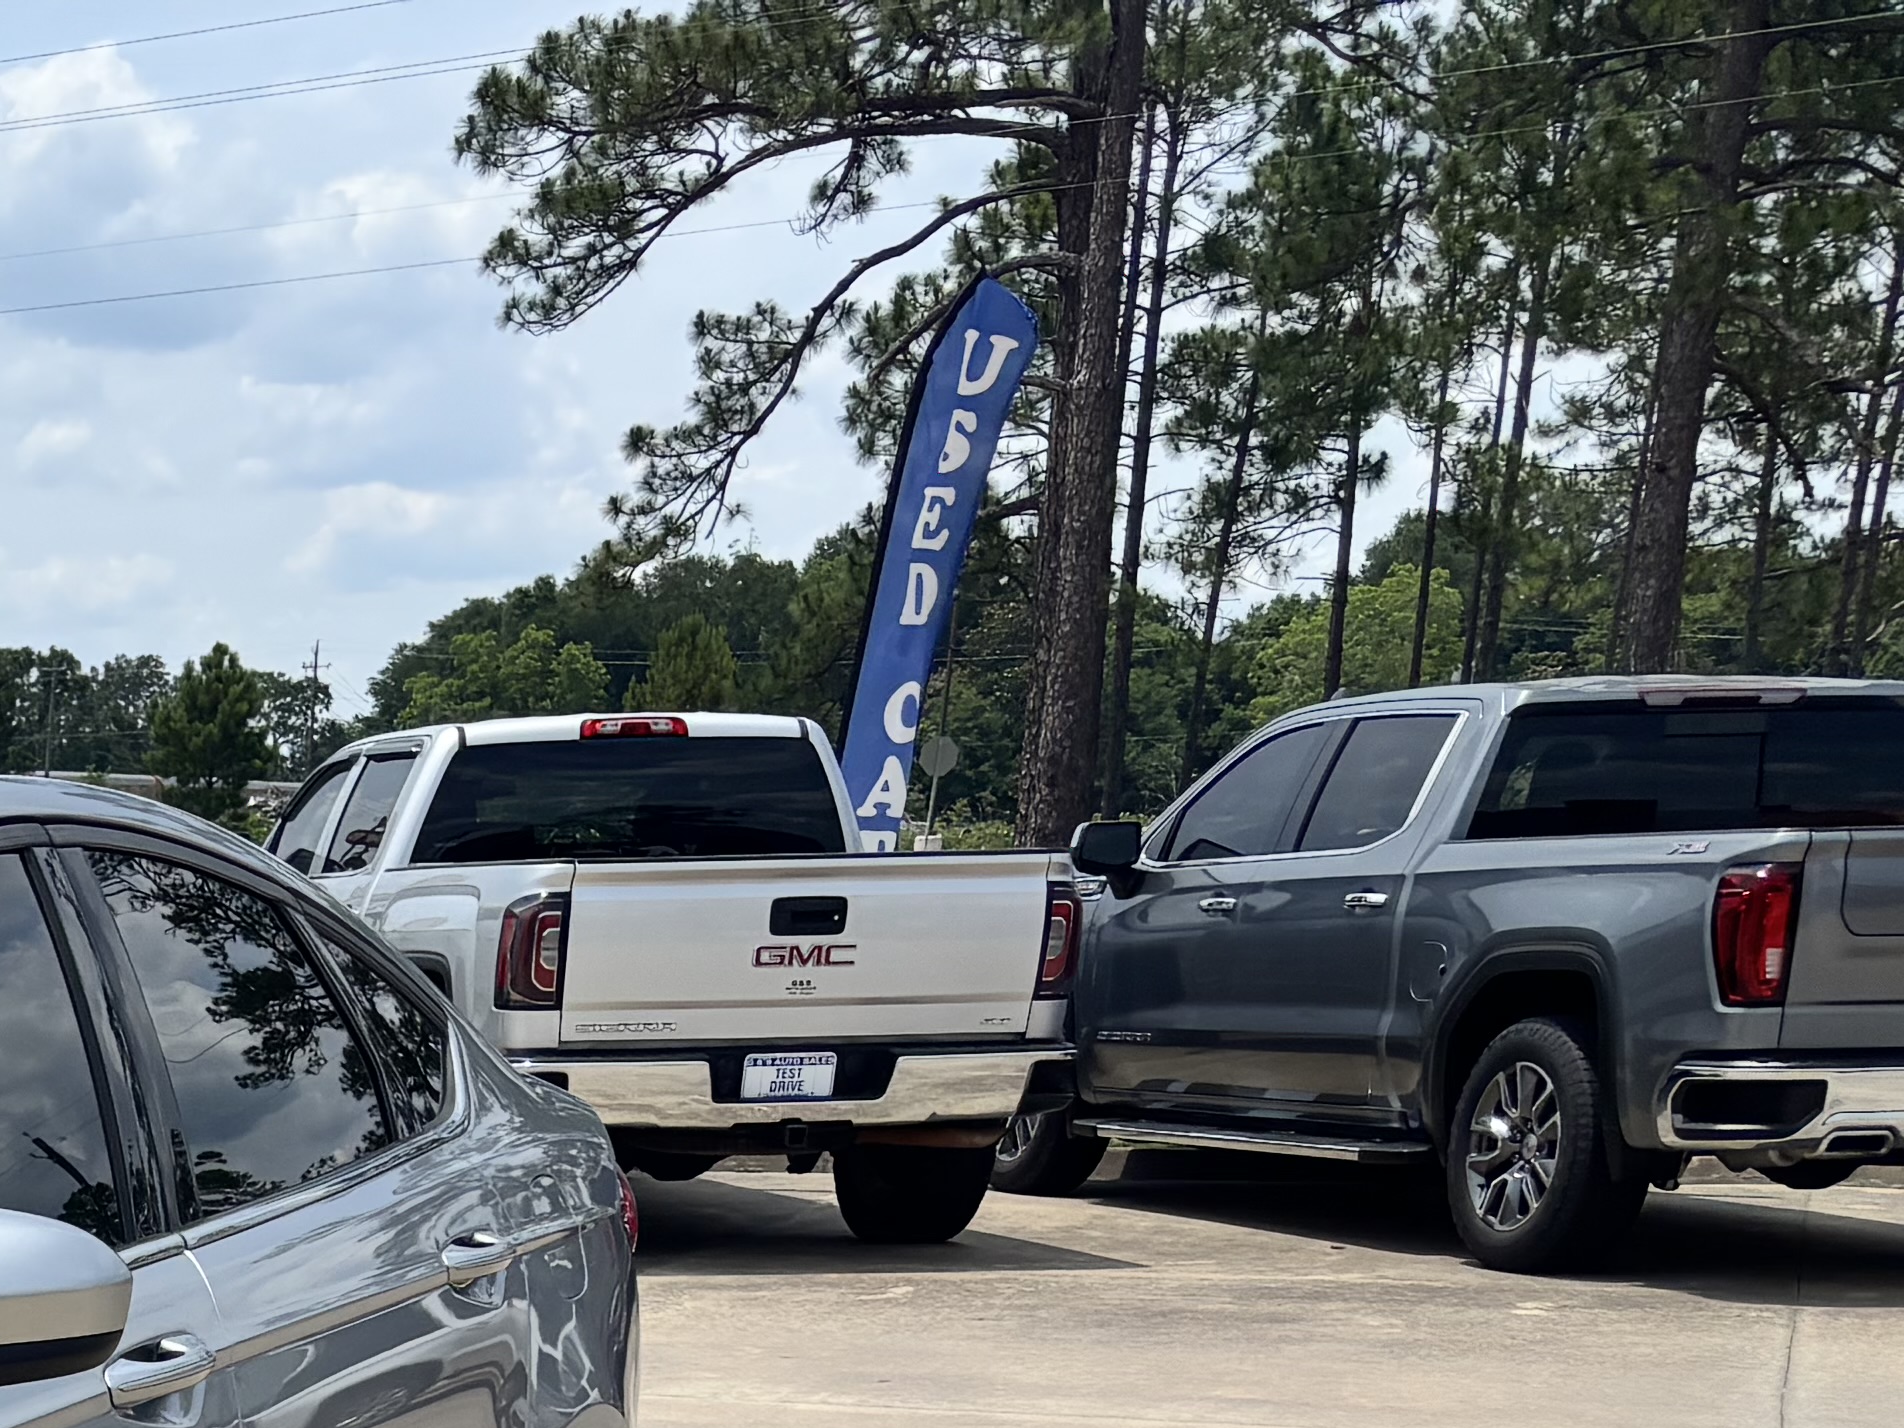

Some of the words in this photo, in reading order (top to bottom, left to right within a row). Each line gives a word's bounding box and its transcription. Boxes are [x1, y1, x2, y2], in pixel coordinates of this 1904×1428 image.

[898, 328, 1020, 626] USED
[752, 944, 857, 967] GMC
[774, 1056, 801, 1066] AUTO
[802, 1055, 834, 1065] SALES
[775, 1067, 803, 1080] TEST
[769, 1080, 805, 1093] DRIVE
